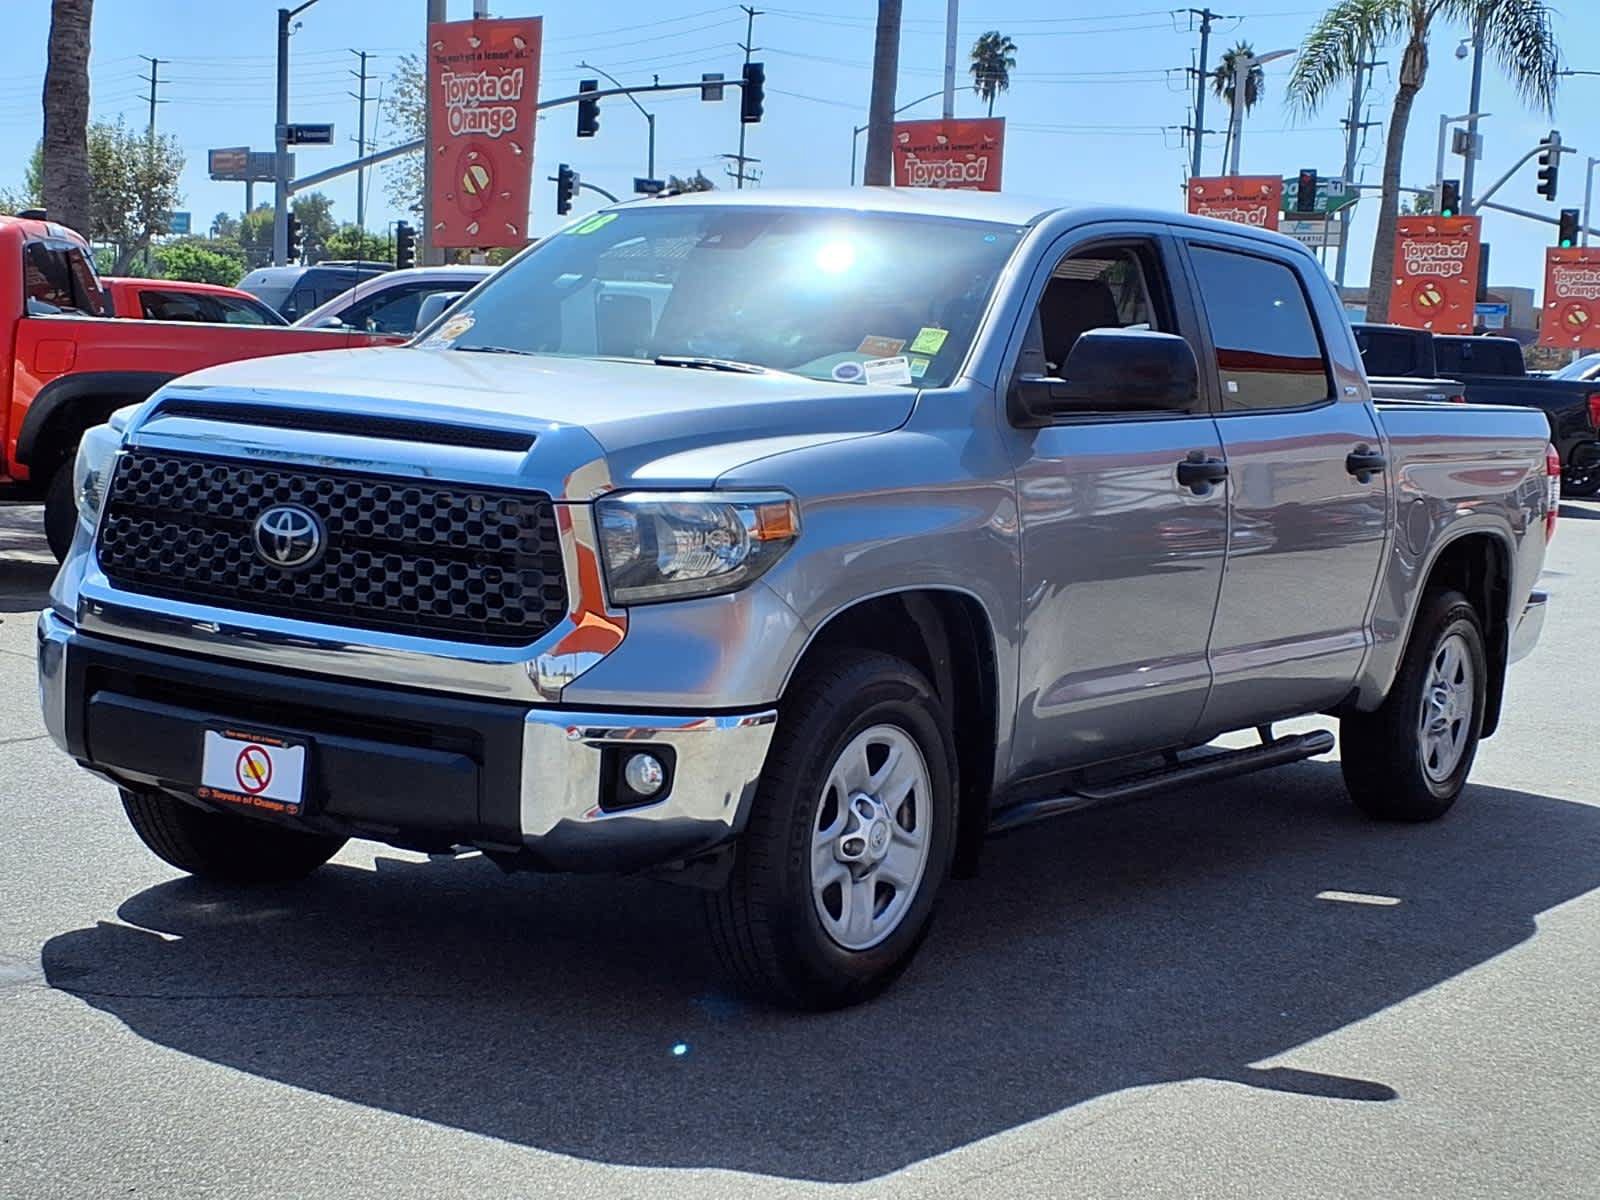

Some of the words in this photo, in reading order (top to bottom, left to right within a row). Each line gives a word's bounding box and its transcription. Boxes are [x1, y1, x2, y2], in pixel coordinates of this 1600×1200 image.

[441, 71, 499, 107] Toyota
[499, 69, 523, 100] of
[448, 103, 517, 138] Orange
[905, 159, 965, 186] Toyota
[965, 156, 988, 182] of
[1247, 205, 1267, 226] of
[1402, 241, 1450, 260] Toyota
[1450, 241, 1468, 259] of
[1406, 260, 1463, 278] Orange
[1553, 268, 1595, 285] Toyota
